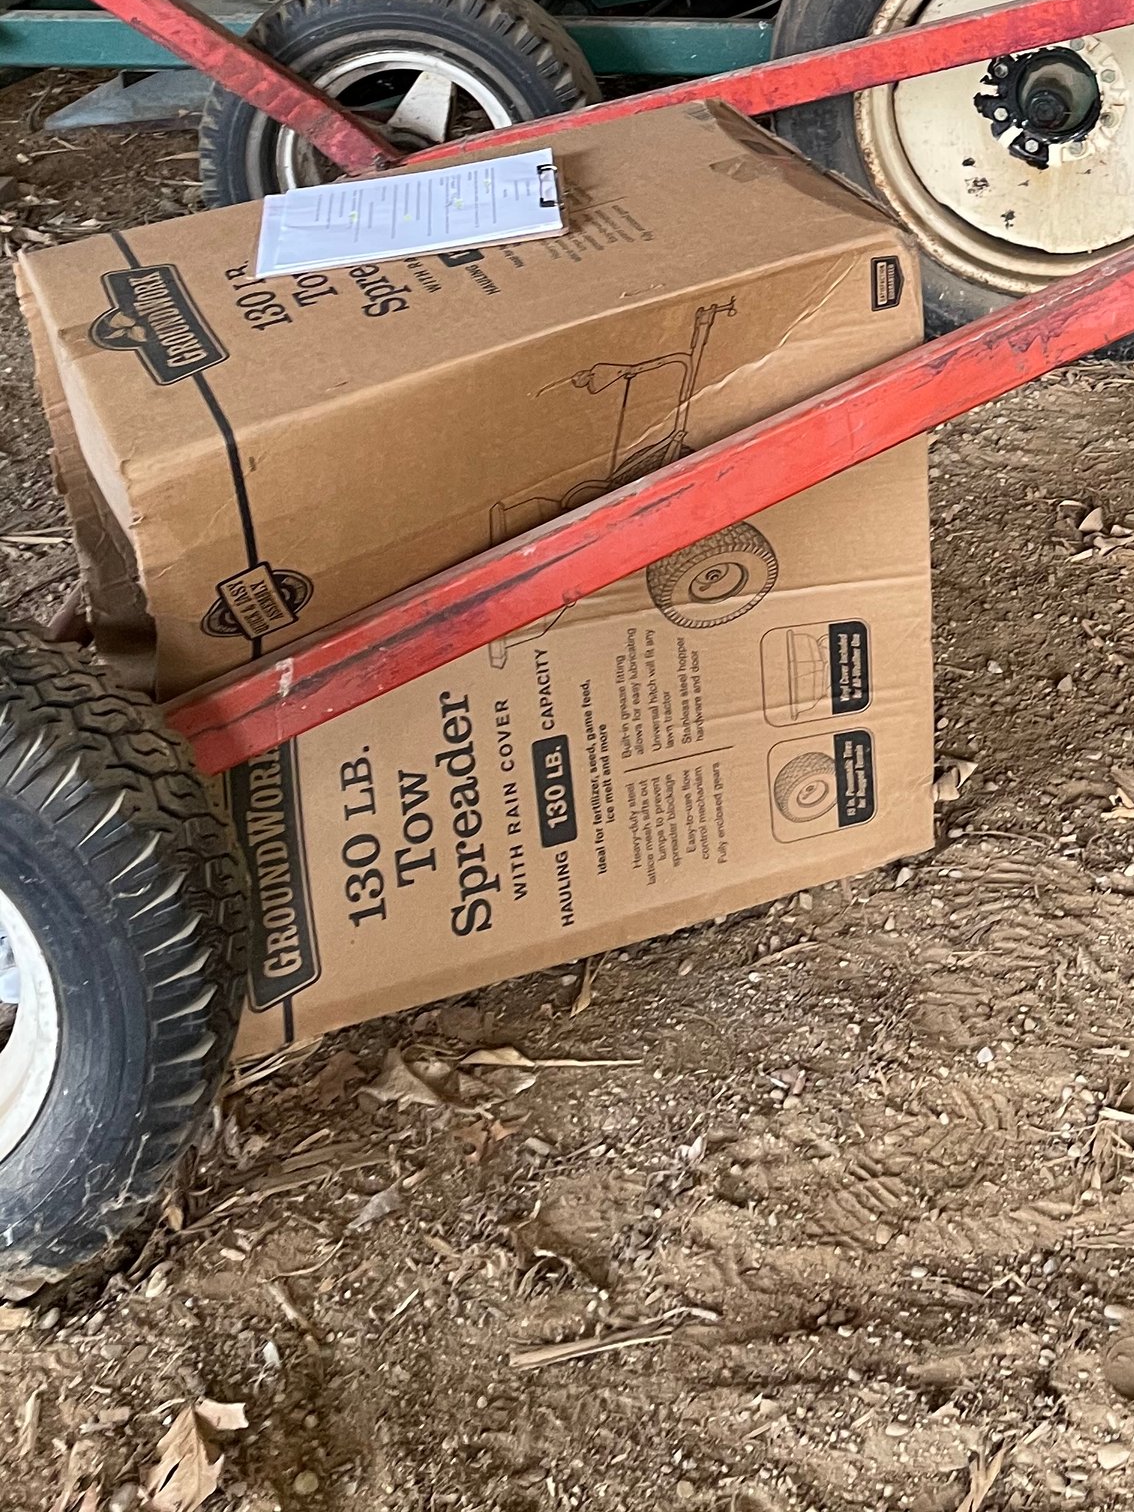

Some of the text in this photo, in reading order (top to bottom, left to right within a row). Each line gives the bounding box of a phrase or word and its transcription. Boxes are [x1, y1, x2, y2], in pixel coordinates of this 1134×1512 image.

[291, 272, 339, 308] To
[345, 263, 412, 318] Spre
[414, 268, 442, 294] WITH
[465, 264, 501, 296] HAULING
[235, 290, 293, 331] 130
[598, 724, 609, 753] more
[533, 649, 575, 928] HAULING 130 LB. CAPACITY
[579, 679, 608, 875] Ideal for fertilizer, seed, game feed,
[598, 755, 611, 776] and
[434, 691, 501, 937] Spreader
[494, 698, 528, 902] WITH RAIN COVER
[602, 778, 614, 804] melt
[339, 745, 387, 928] 130 LB.
[394, 769, 437, 889] Tow
